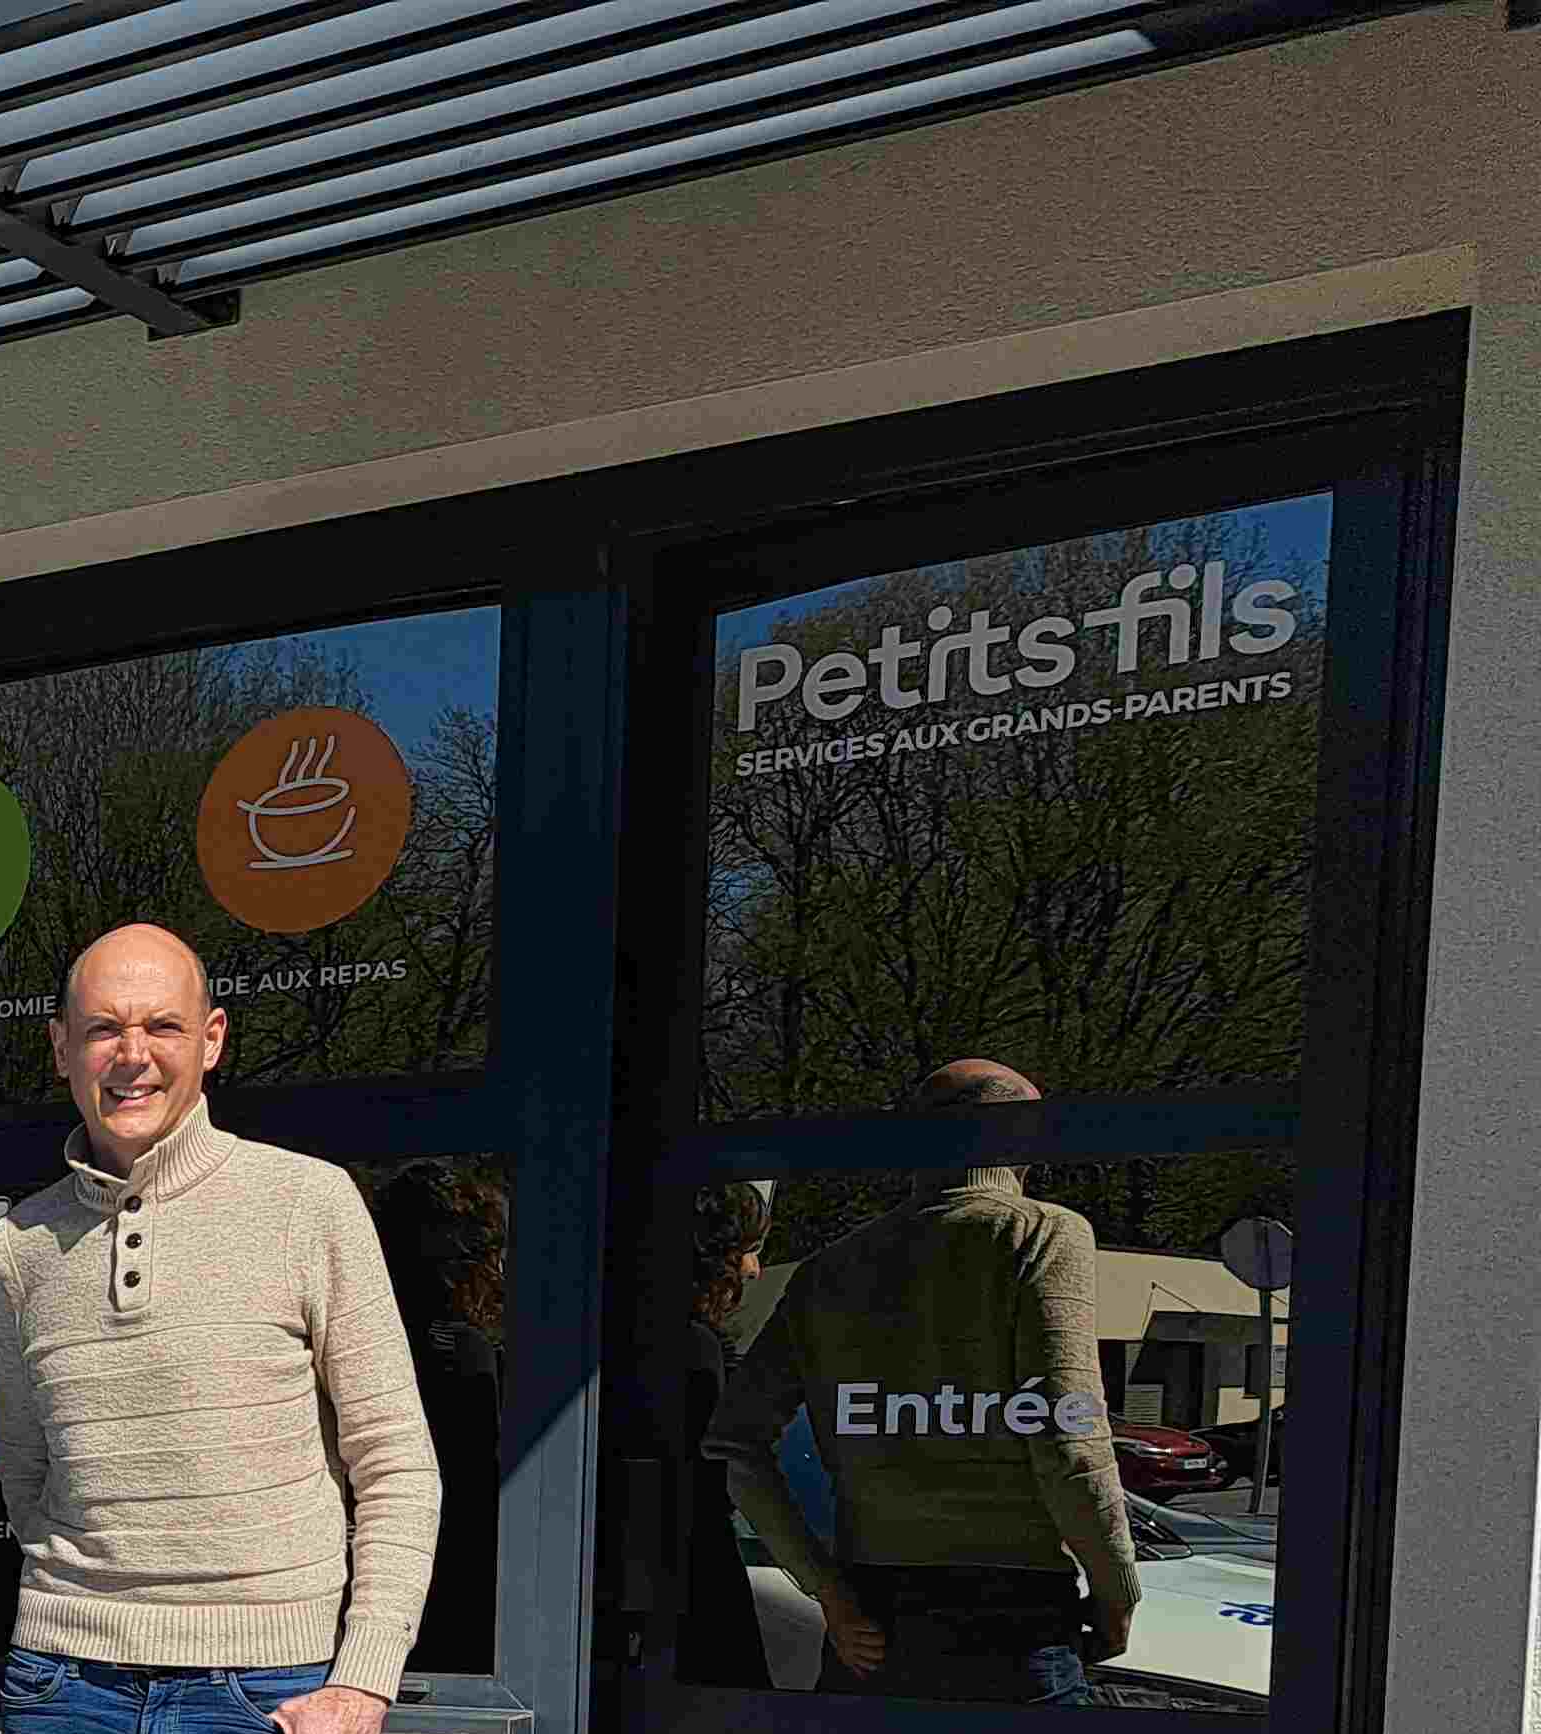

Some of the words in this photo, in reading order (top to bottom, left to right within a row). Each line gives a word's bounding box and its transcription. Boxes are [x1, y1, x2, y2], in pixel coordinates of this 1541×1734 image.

[735, 731, 886, 778] SERVICES
[892, 722, 961, 756] AUX
[967, 671, 1293, 743] GRANDS-PARENTS
[207, 975, 251, 998] IDE
[256, 968, 313, 993] AUX
[319, 958, 408, 987] REPAS
[835, 1376, 1107, 1437] Entrée
